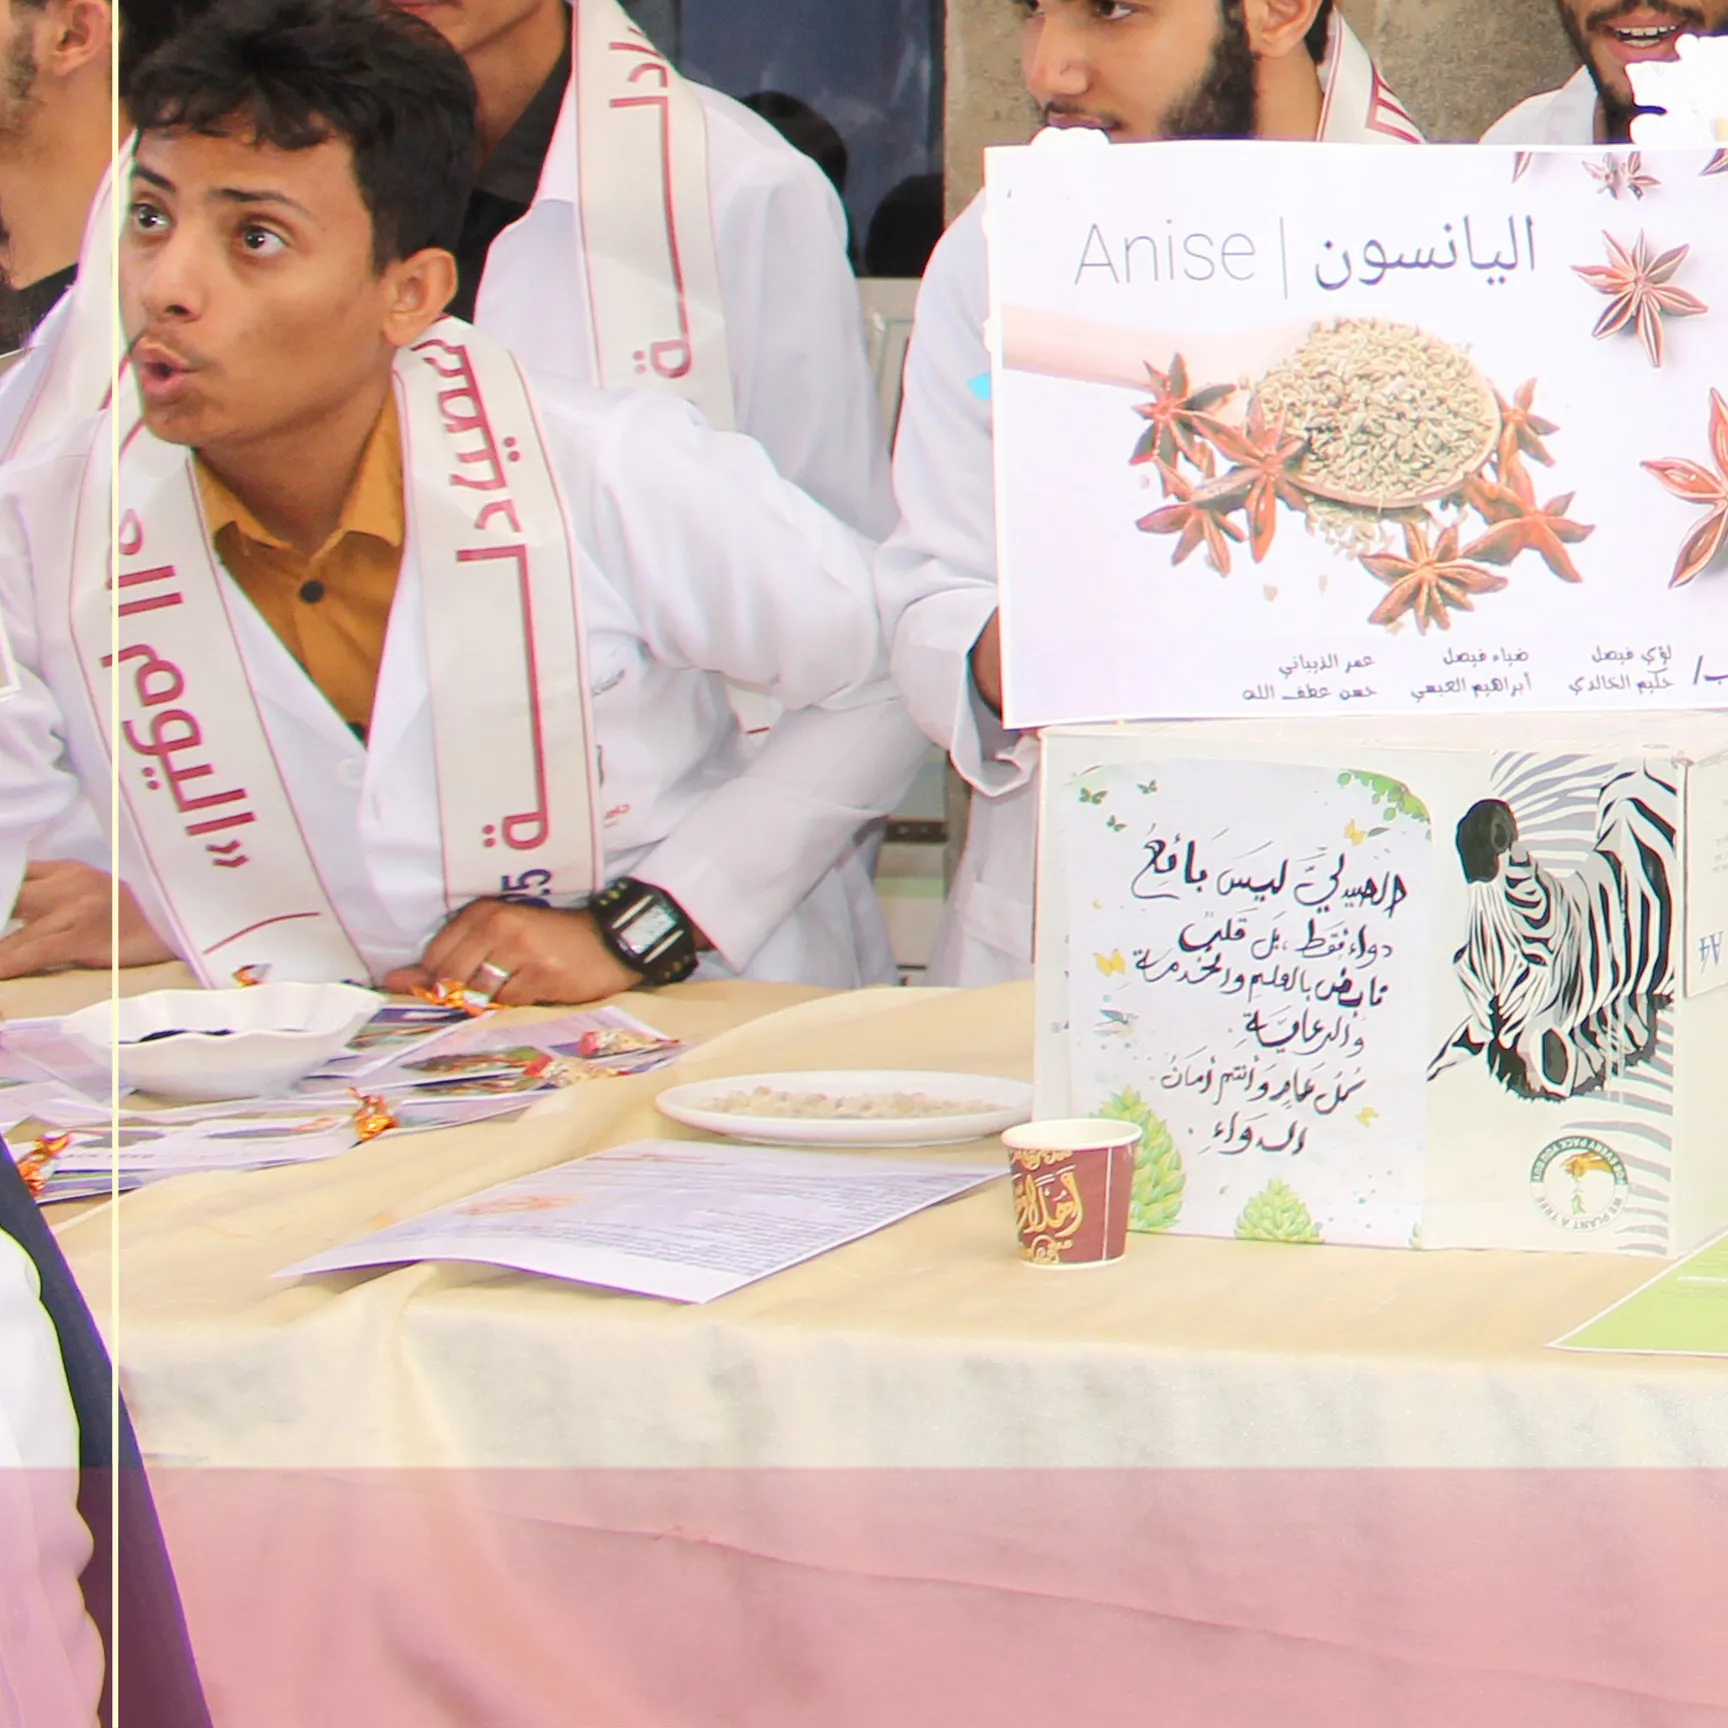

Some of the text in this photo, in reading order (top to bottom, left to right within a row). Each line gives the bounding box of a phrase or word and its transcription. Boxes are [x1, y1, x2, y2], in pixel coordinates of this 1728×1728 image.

[1074, 218, 1256, 286] Anise
[1315, 214, 1536, 291] اليانسون
[1345, 655, 1377, 674] عمر
[1443, 646, 1488, 669] فيصل
[1591, 645, 1635, 666] فيصل
[1242, 683, 1276, 702] الله
[1569, 667, 1675, 697] حكيم الخالدي
[1698, 929, 1724, 975] A4
[1560, 1136, 1588, 1150] PACK
[1587, 1139, 1618, 1166] EVERY
[1572, 1213, 1611, 1230] PLANT
